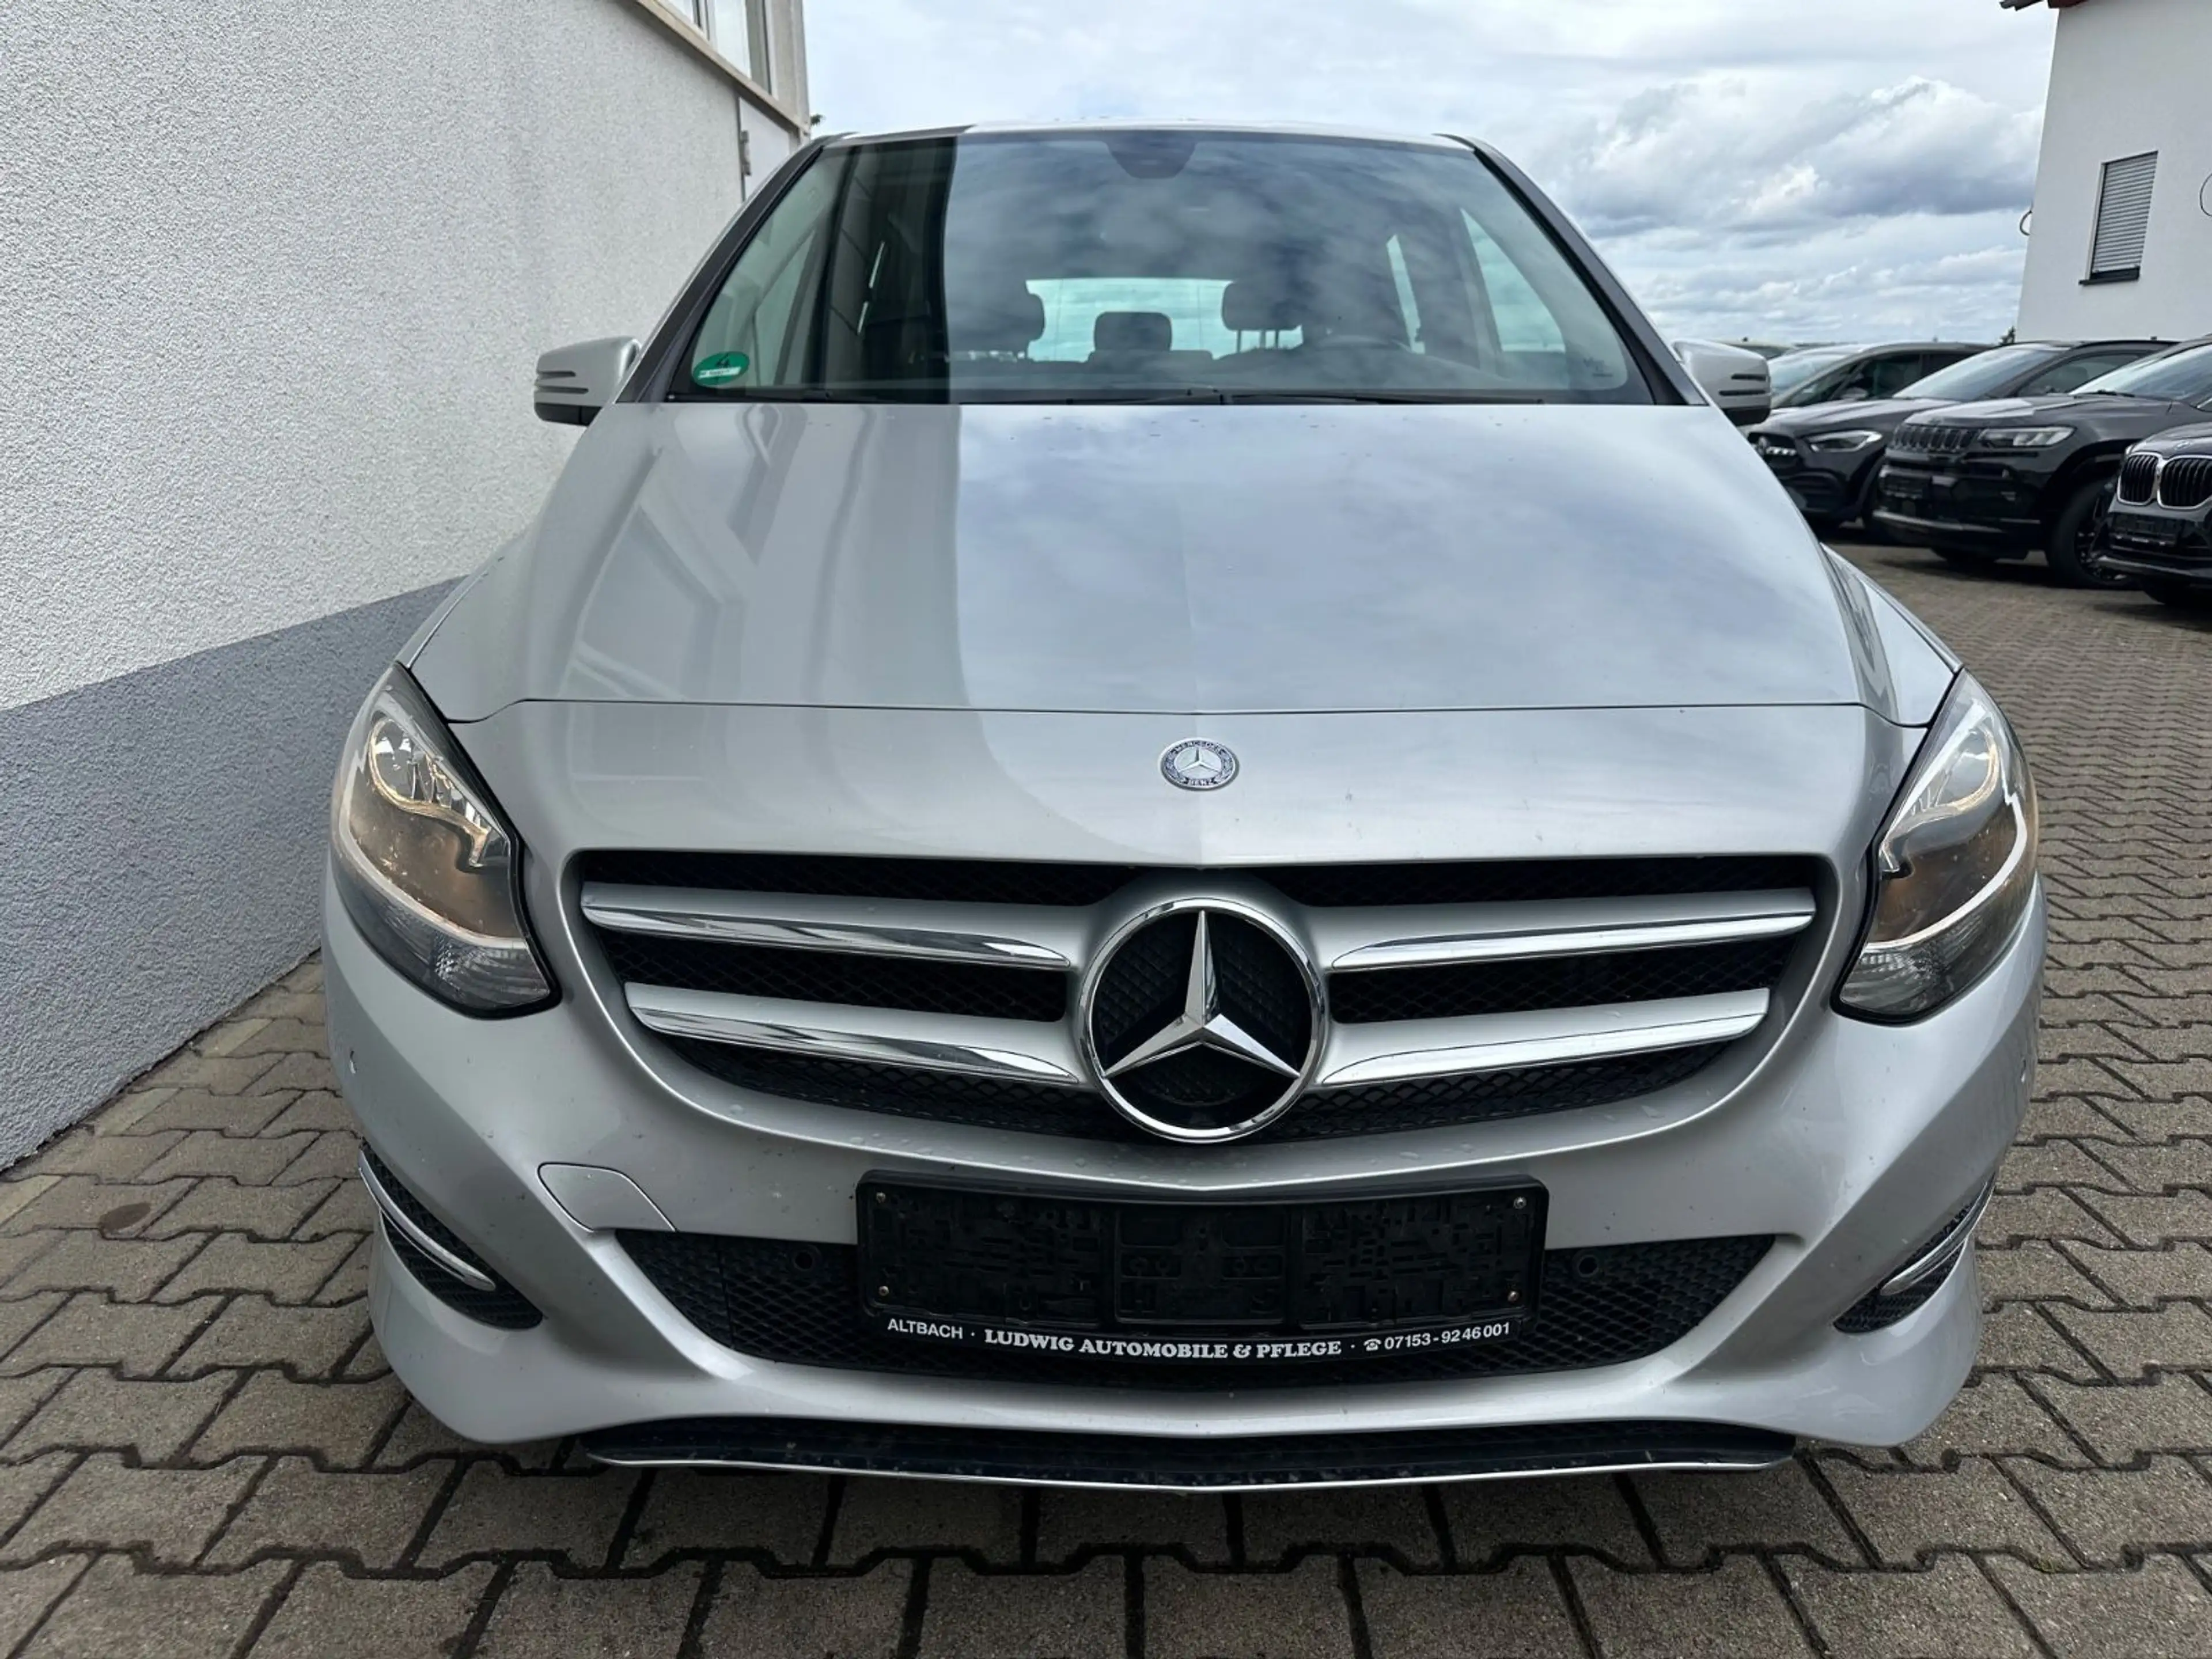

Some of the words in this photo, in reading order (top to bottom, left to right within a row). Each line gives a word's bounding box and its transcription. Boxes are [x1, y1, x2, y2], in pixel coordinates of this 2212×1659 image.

[888, 1319, 963, 1339] ALTBACH
[985, 1330, 1074, 1351] LUDWIG
[1079, 1339, 1228, 1358] AUTOMOBILE
[1233, 1344, 1252, 1358] &
[1257, 1341, 1341, 1358] PFLEGE
